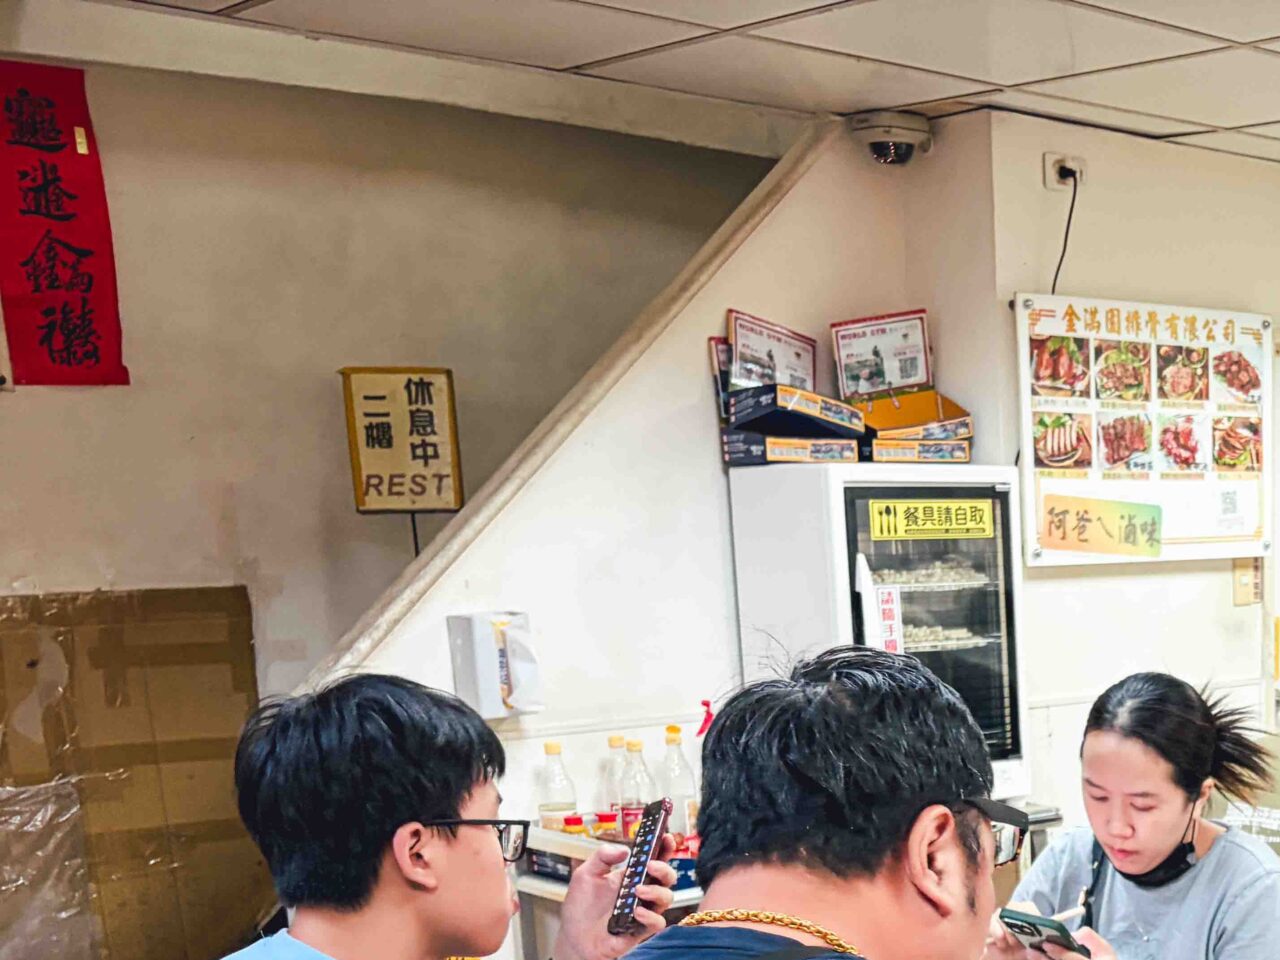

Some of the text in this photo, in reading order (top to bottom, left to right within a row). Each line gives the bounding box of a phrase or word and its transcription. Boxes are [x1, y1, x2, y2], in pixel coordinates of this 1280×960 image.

[1061, 303, 1237, 346] 金滿園排骨有限公司
[362, 394, 394, 450] 二樓
[403, 377, 440, 468] 休息中
[364, 472, 451, 497] REST
[903, 504, 986, 528] 餐具請自取
